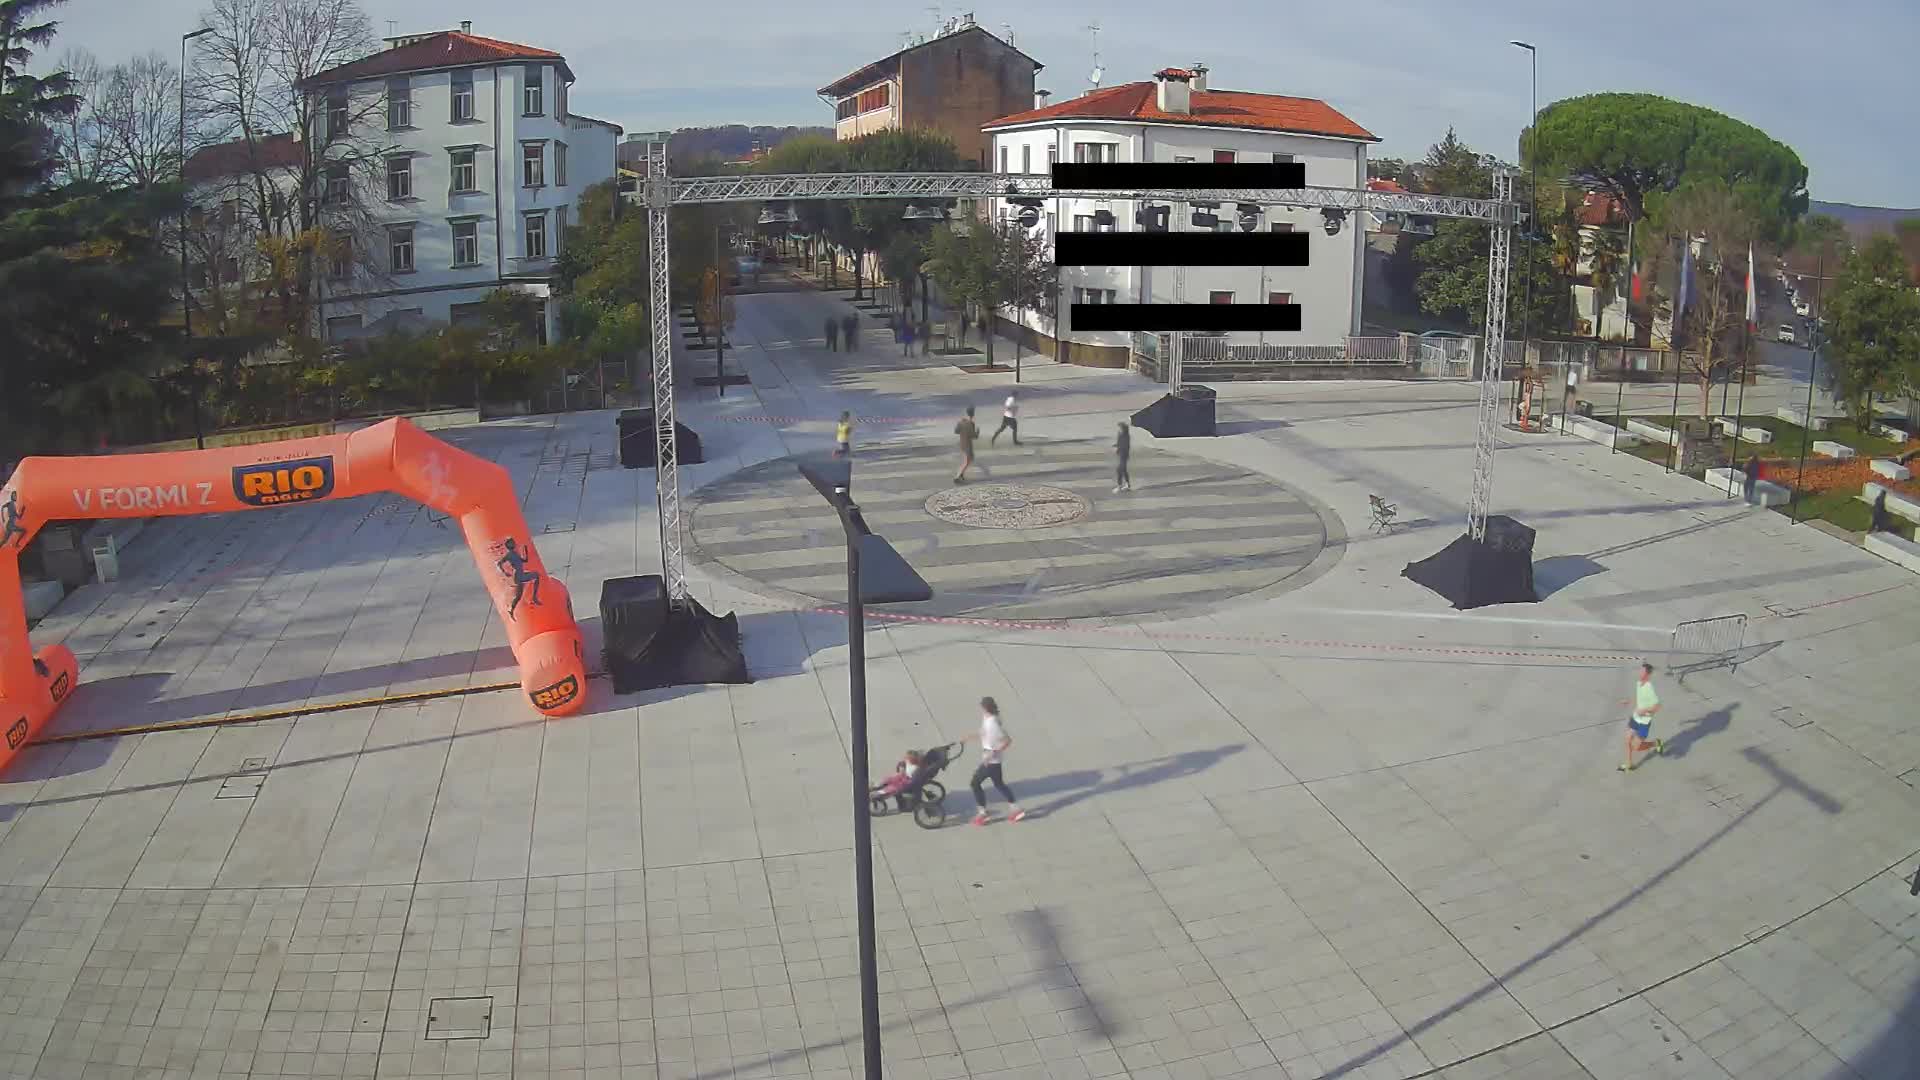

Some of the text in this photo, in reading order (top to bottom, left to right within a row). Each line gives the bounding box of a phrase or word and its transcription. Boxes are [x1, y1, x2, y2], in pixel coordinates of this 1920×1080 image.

[243, 465, 324, 497] RIO
[261, 491, 313, 504] mare
[535, 682, 574, 705] RIO
